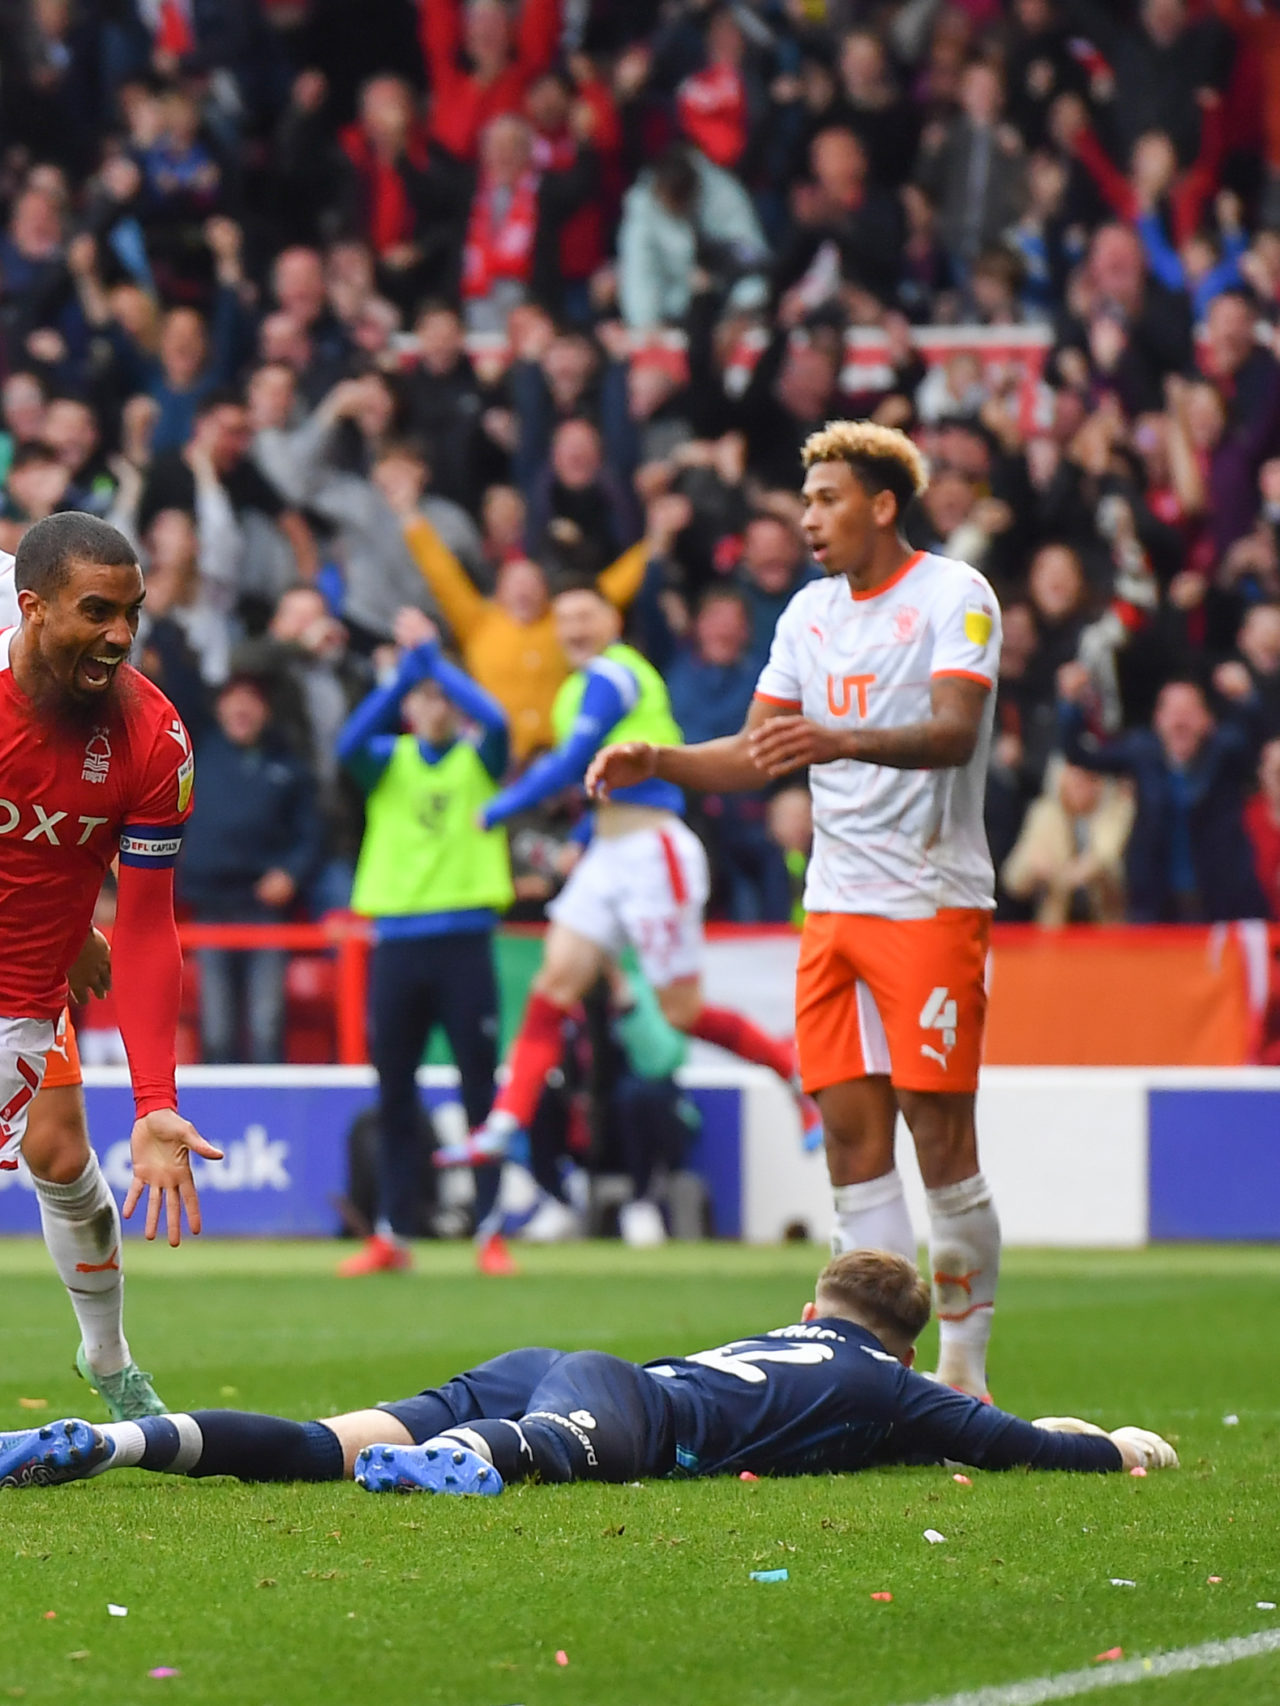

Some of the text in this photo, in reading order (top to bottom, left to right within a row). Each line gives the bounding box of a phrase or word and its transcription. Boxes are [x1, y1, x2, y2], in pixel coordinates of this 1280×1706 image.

[827, 673, 876, 718] UT
[131, 841, 149, 852] EFL
[919, 986, 957, 1046] 4
